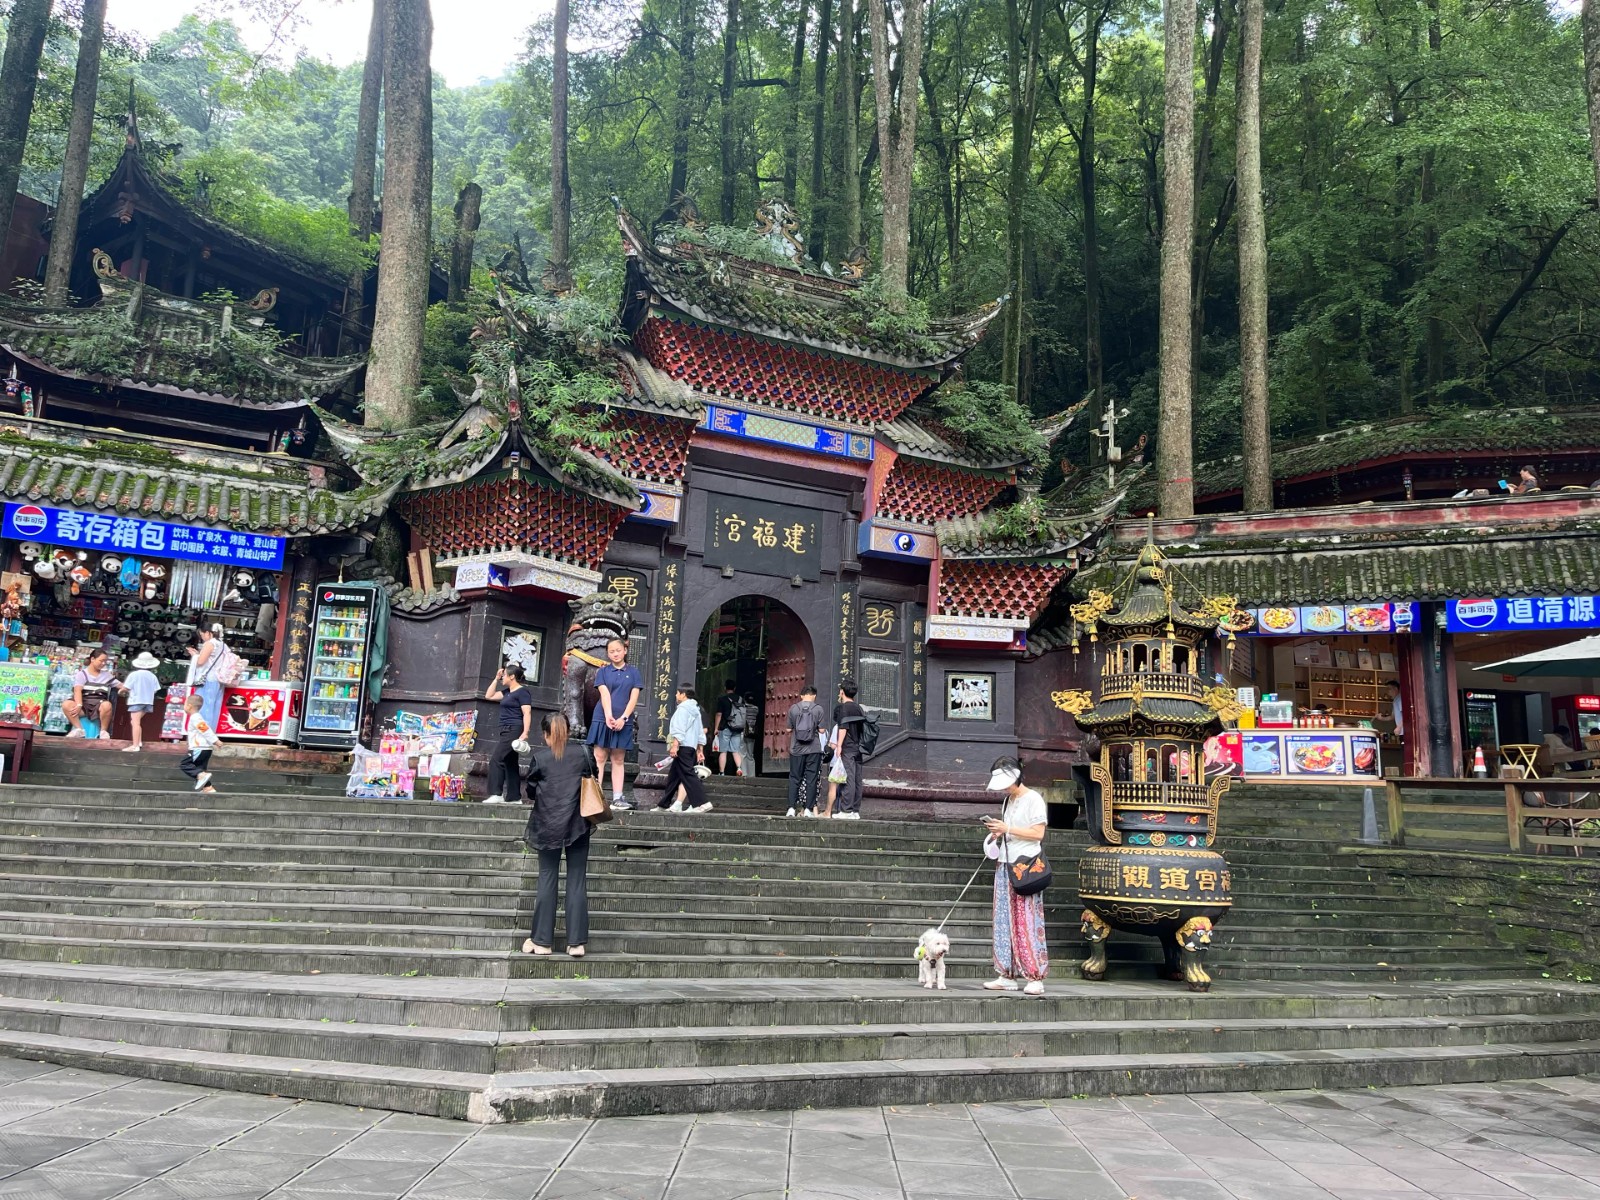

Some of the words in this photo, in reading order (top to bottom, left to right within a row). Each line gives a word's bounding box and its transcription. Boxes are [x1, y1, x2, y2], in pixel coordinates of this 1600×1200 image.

[15, 514, 45, 525] 百事可乐
[56, 511, 165, 551] 寄存箱包
[1458, 605, 1495, 614] 百事可乐
